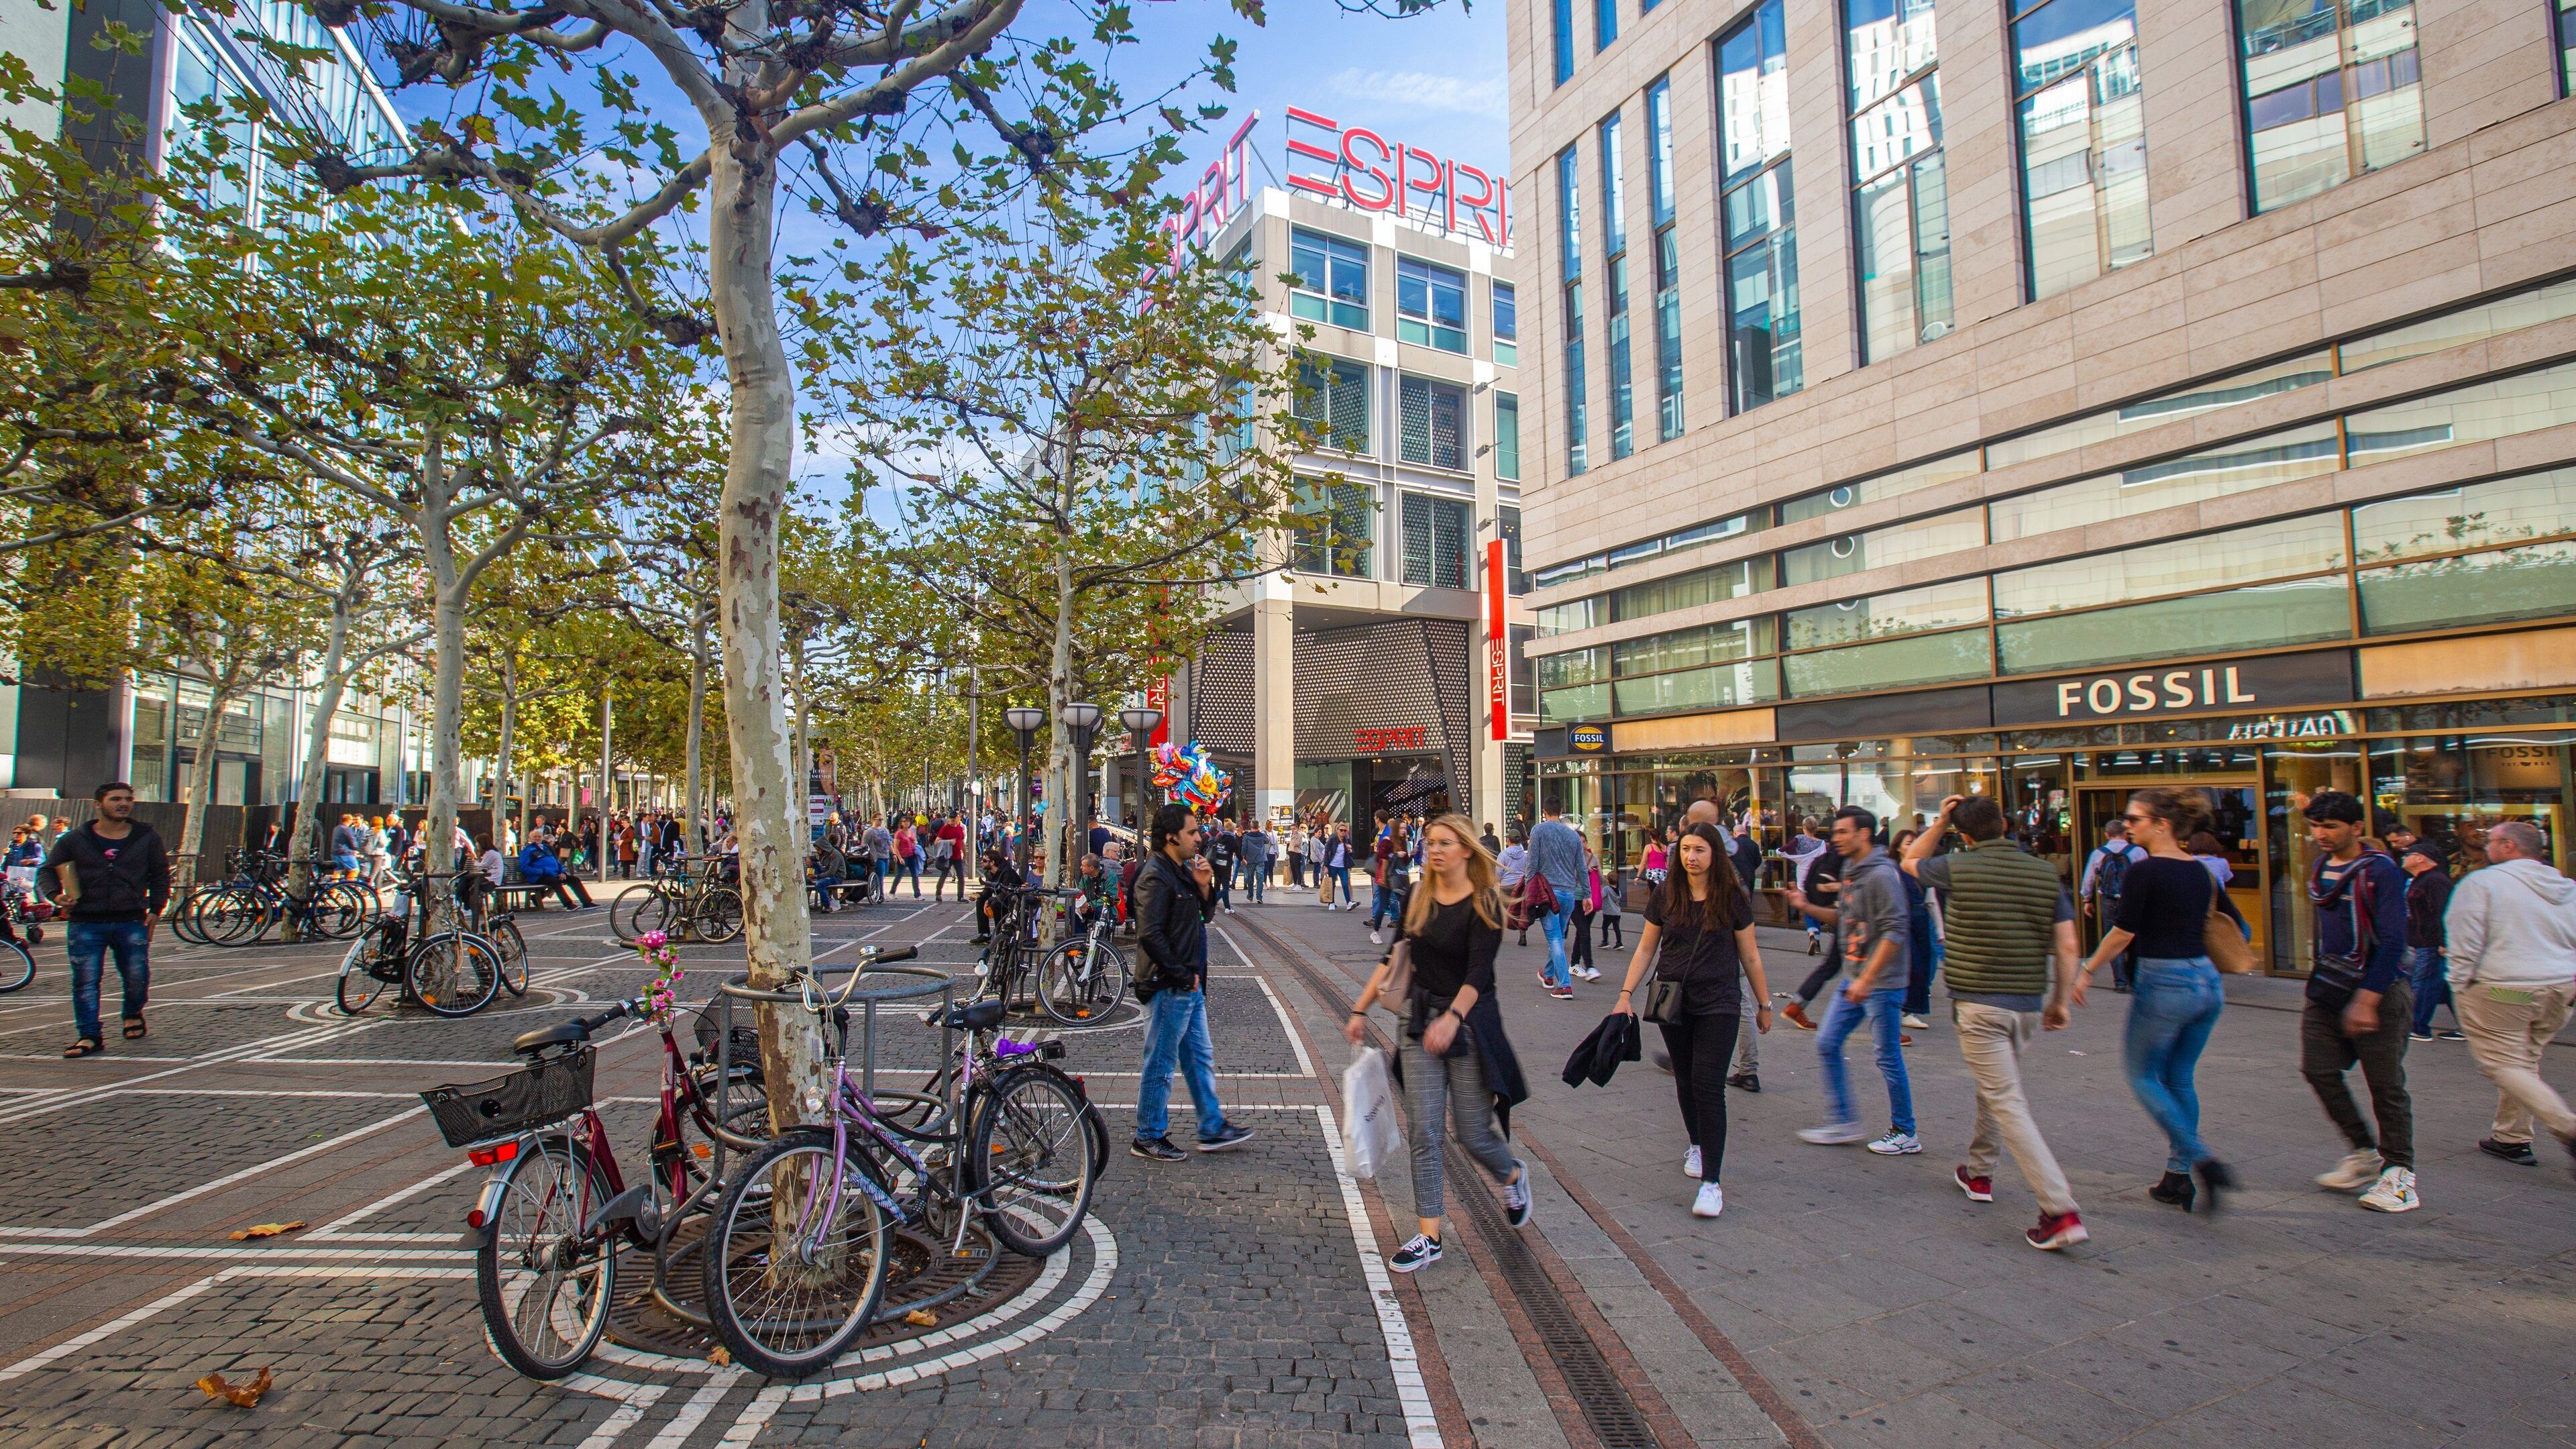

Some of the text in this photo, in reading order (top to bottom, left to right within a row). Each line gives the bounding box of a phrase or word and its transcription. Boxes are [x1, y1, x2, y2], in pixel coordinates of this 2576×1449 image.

[1286, 105, 1510, 247] ESPRI
[1491, 637, 1505, 706] ESPRIT
[2058, 666, 2256, 716] FOSSIL
[1354, 726, 1428, 751] ESPRIT
[1574, 734, 1605, 743] FOSSIL
[2486, 746, 2559, 758] FOSSI
